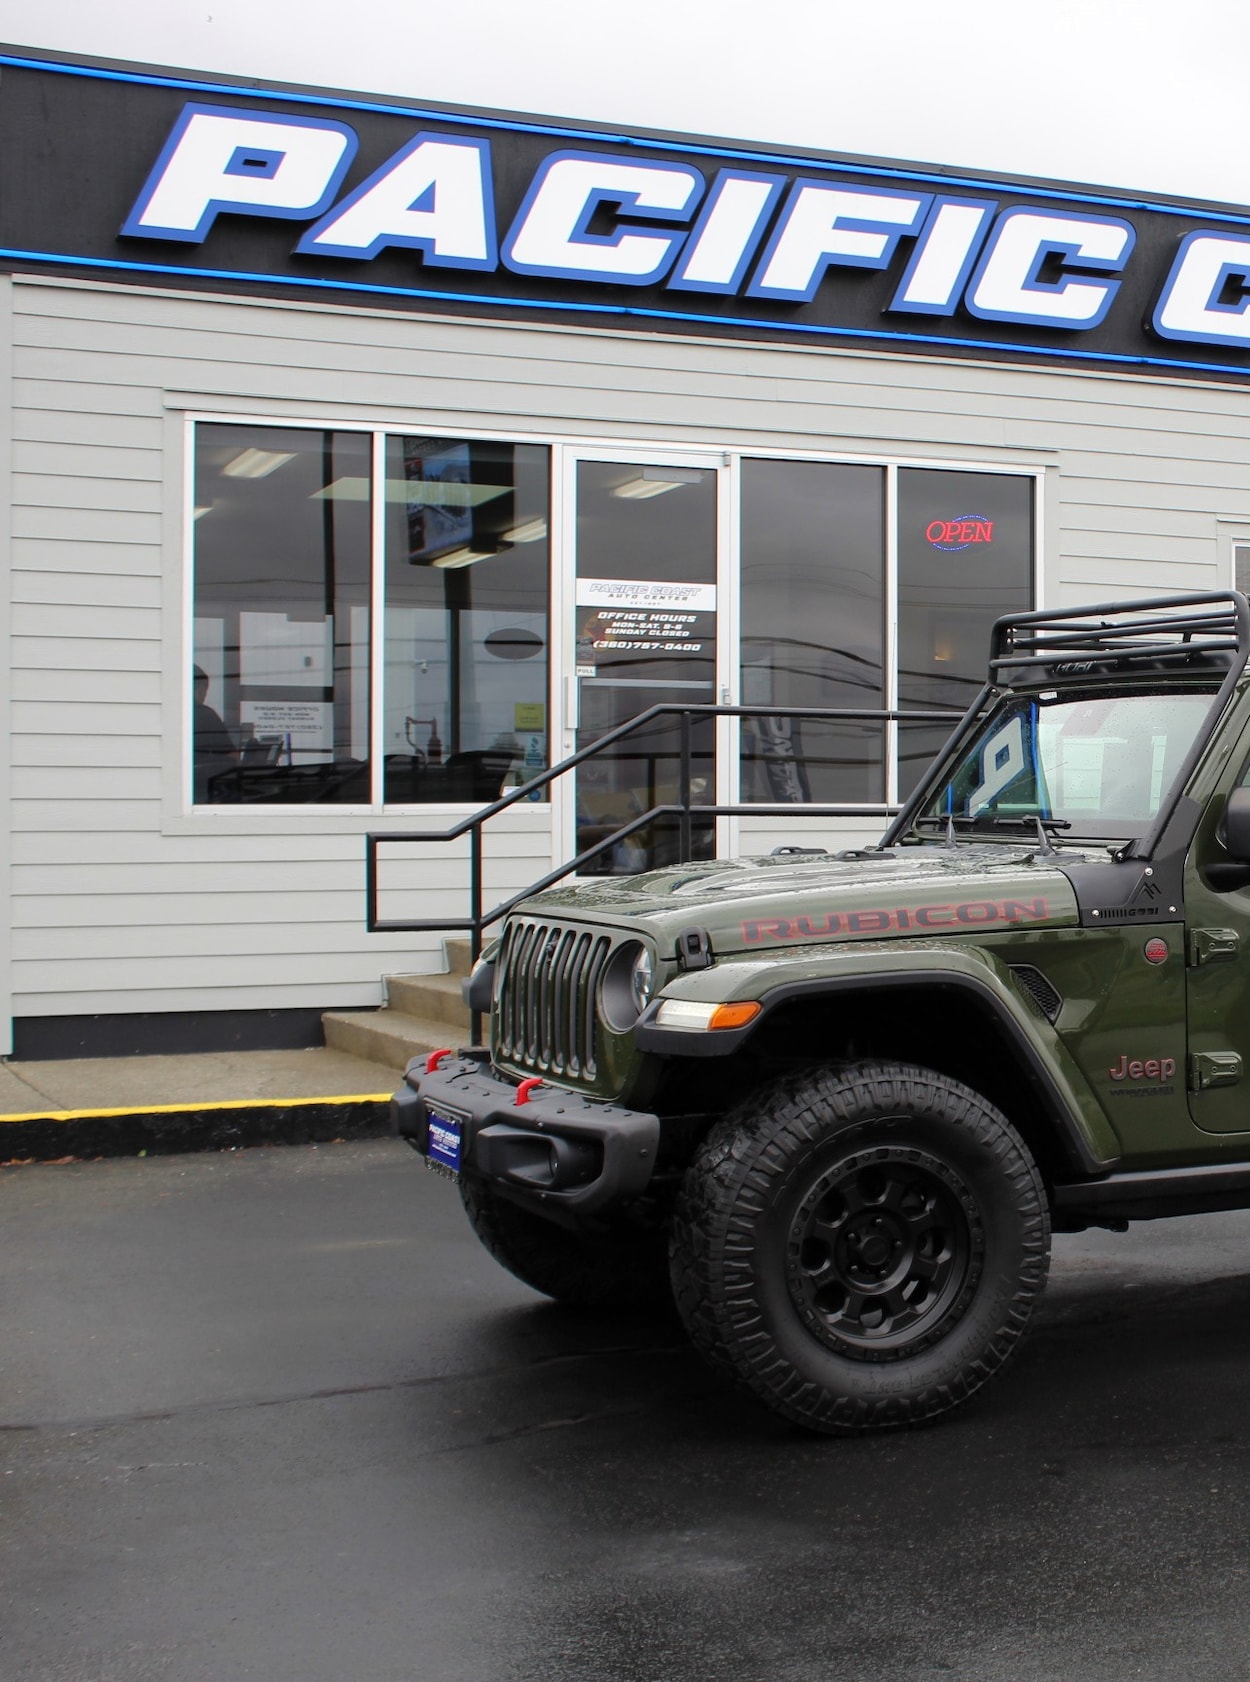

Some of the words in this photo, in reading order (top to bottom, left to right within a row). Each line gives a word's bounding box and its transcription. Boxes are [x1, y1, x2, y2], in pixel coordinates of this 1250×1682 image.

[120, 102, 1137, 331] PACIFIC
[926, 520, 994, 543] OPEN
[589, 583, 648, 595] PACIFIC
[650, 585, 702, 598] COAST
[597, 611, 647, 621] OFFICE
[649, 614, 697, 623] HOURS
[611, 621, 660, 630] MON-SAT.
[648, 629, 690, 637] CLOSED
[593, 640, 702, 652] (360)757-0400
[740, 898, 1049, 944] RUBICON
[1108, 1055, 1177, 1082] Jeep
